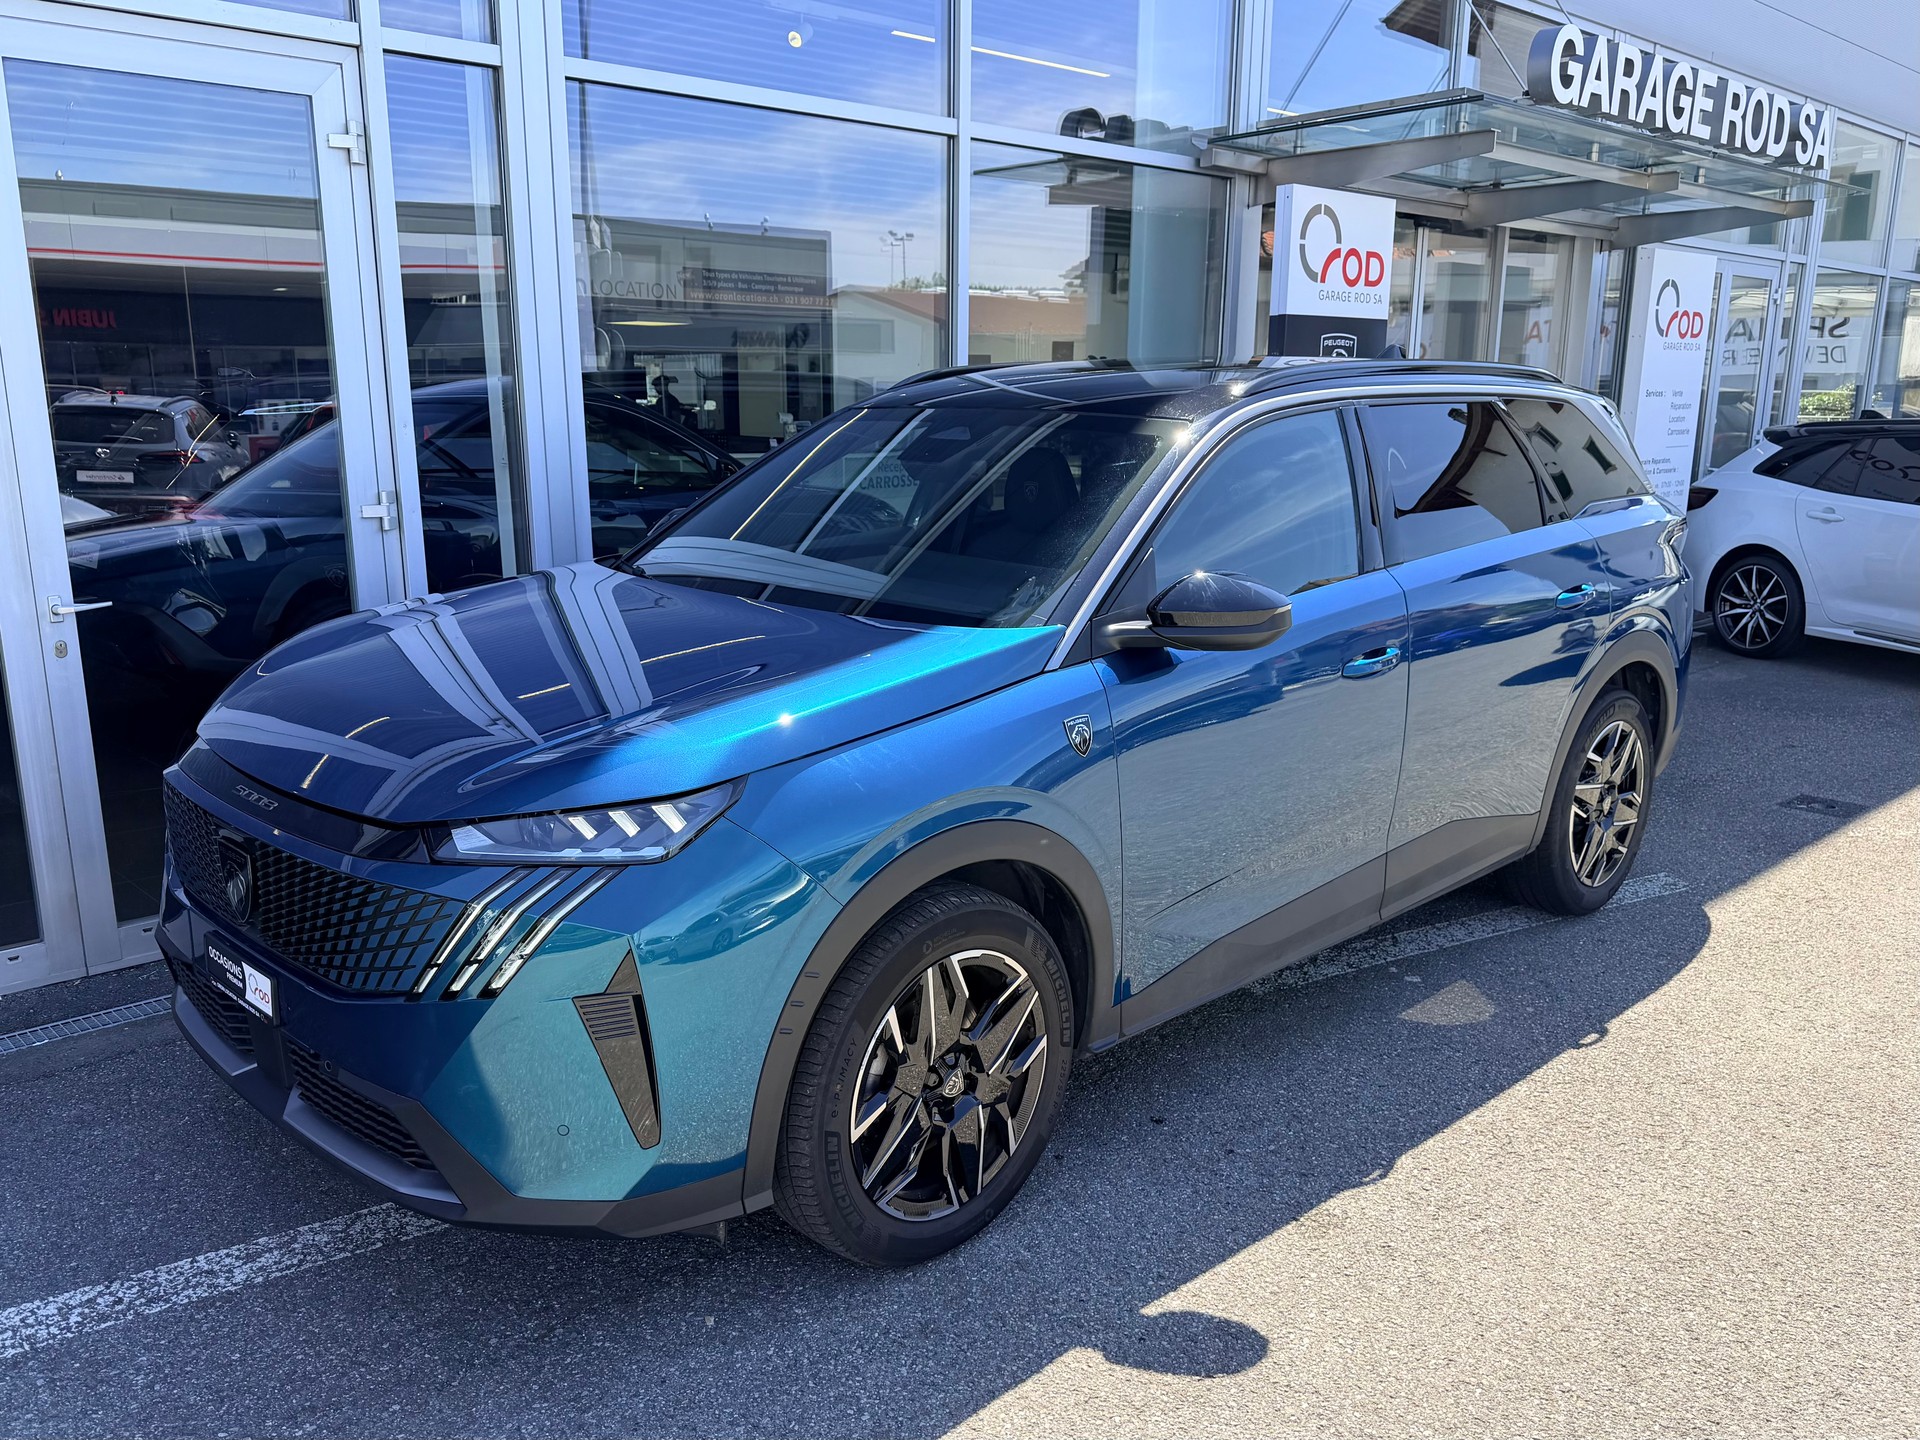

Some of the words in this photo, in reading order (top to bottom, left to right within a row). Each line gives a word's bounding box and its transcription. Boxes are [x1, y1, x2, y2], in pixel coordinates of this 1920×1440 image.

[1550, 23, 1720, 140] GARAGE
[1720, 78, 1791, 158] ROD
[1795, 103, 1831, 170] SA
[590, 279, 677, 300] LOCATION
[690, 291, 778, 303] www.oronlocation.ch
[1318, 289, 1352, 303] GARAGE
[1354, 292, 1371, 304] ROD
[1373, 293, 1383, 305] SA
[1323, 339, 1354, 348] PEUGEOT
[1662, 341, 1682, 351] GARAGE
[1683, 342, 1694, 351] ROD
[1694, 342, 1701, 351] SA
[1067, 717, 1088, 727] PEUGEOT
[231, 784, 279, 811] 5008
[208, 945, 243, 979] OCCASIONS
[1045, 957, 1071, 1043] MICHELIN
